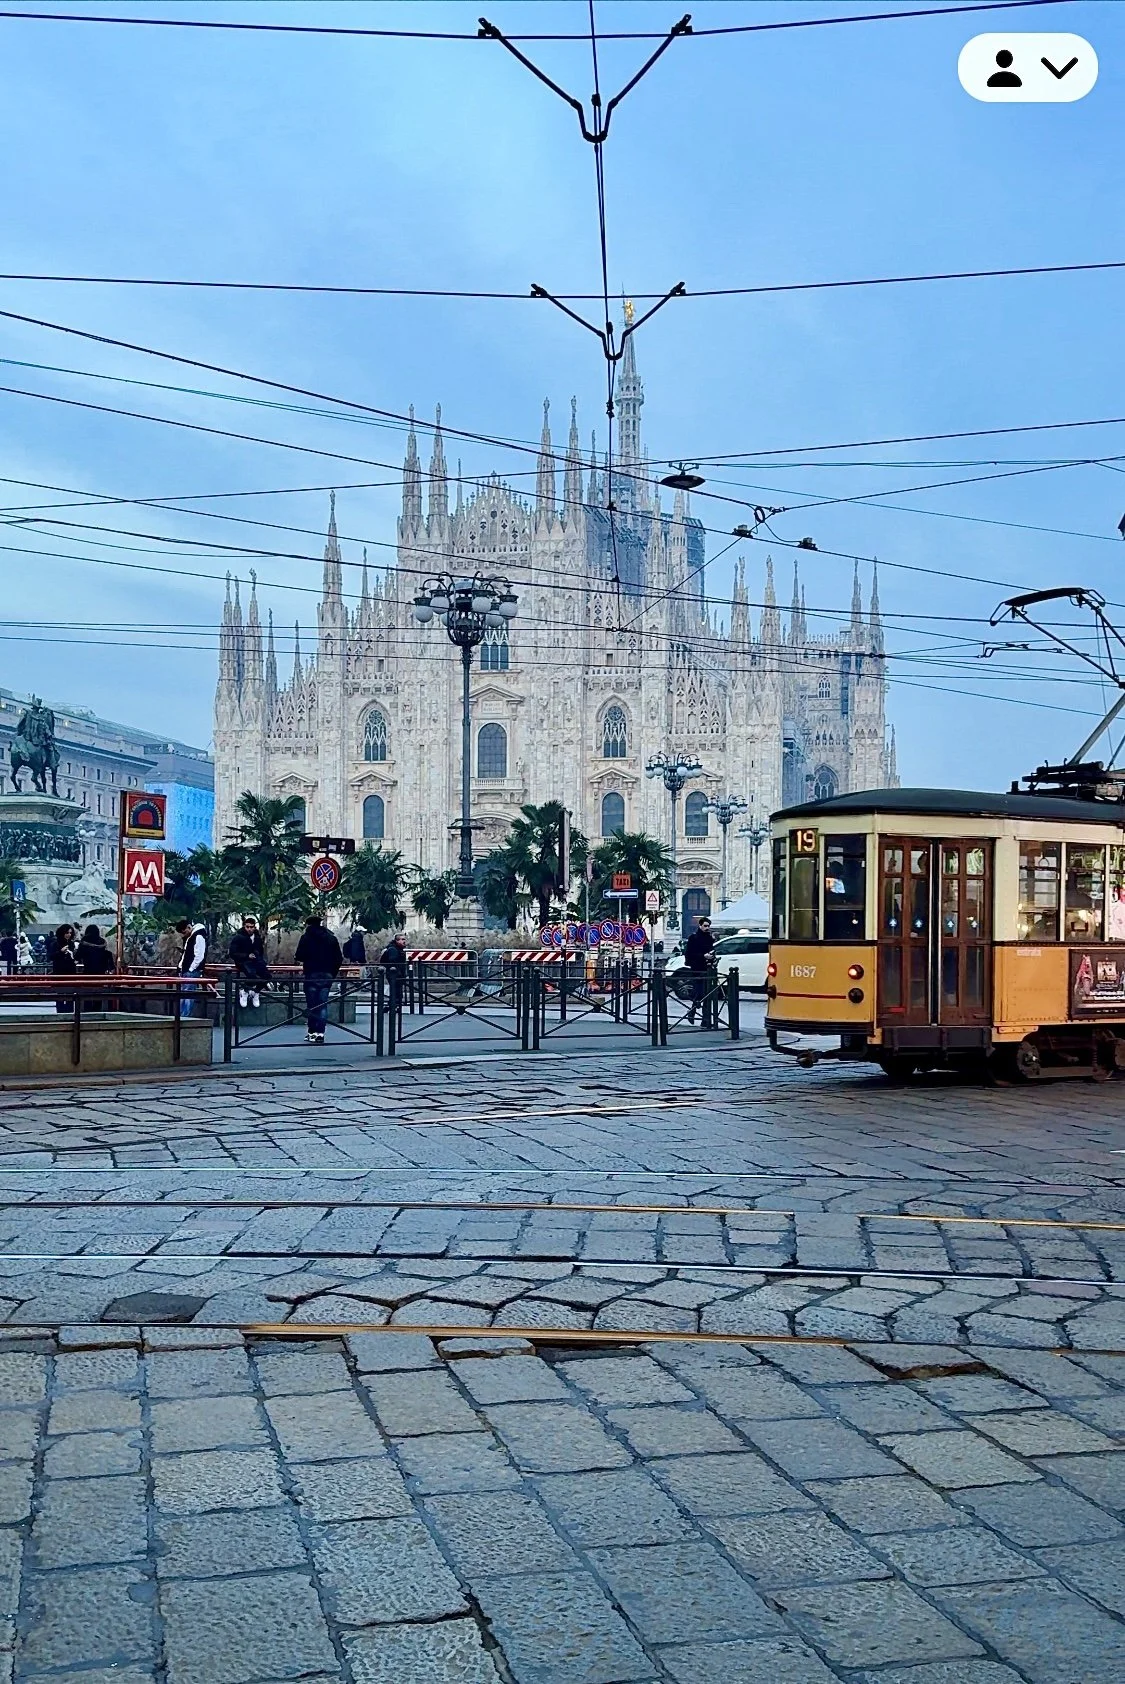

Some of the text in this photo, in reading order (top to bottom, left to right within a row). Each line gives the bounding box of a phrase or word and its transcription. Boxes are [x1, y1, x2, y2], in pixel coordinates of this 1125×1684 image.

[797, 830, 815, 851] 19
[128, 860, 161, 886] M
[615, 878, 629, 886] TAXI
[790, 964, 817, 978] 1687
